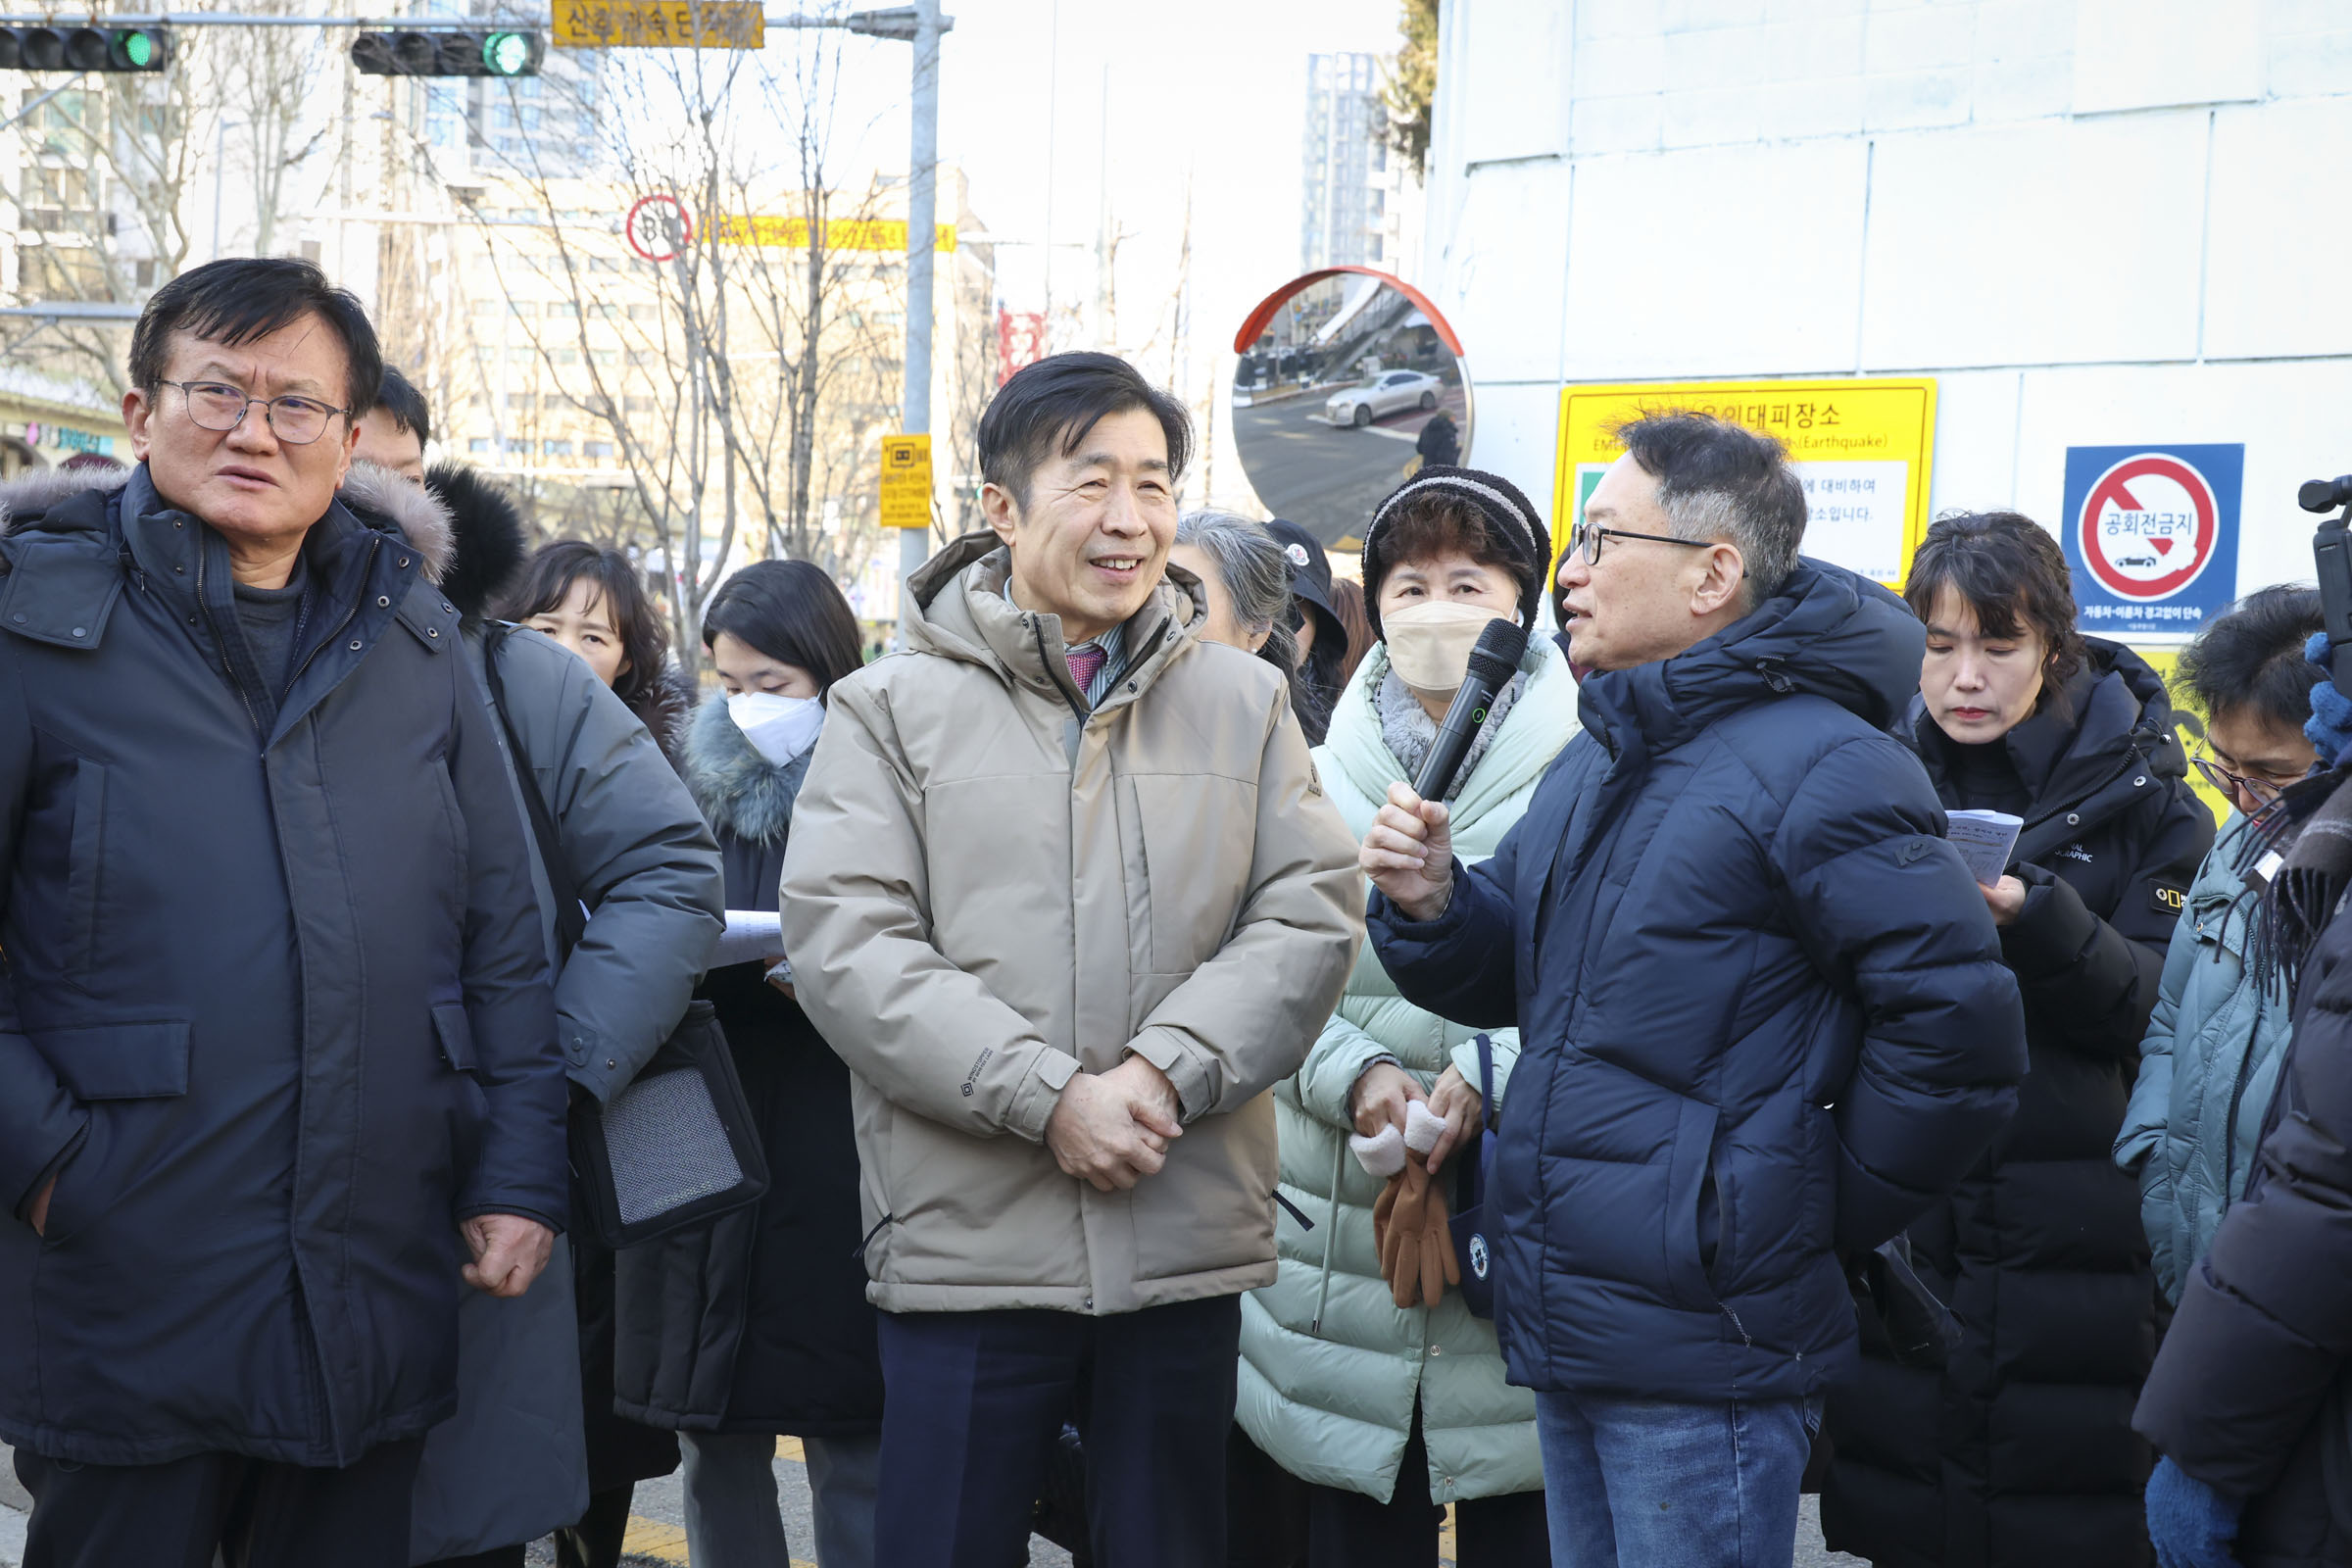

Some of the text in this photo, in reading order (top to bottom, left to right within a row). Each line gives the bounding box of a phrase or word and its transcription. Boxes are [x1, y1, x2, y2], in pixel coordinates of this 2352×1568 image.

[1798, 434, 1887, 451] (Earthquake)
[1821, 478, 1876, 494] 대비하여
[2105, 513, 2192, 535] 공회전금지
[2182, 606, 2203, 620] 단속
[967, 1047, 989, 1081] WINDSTOPPER
